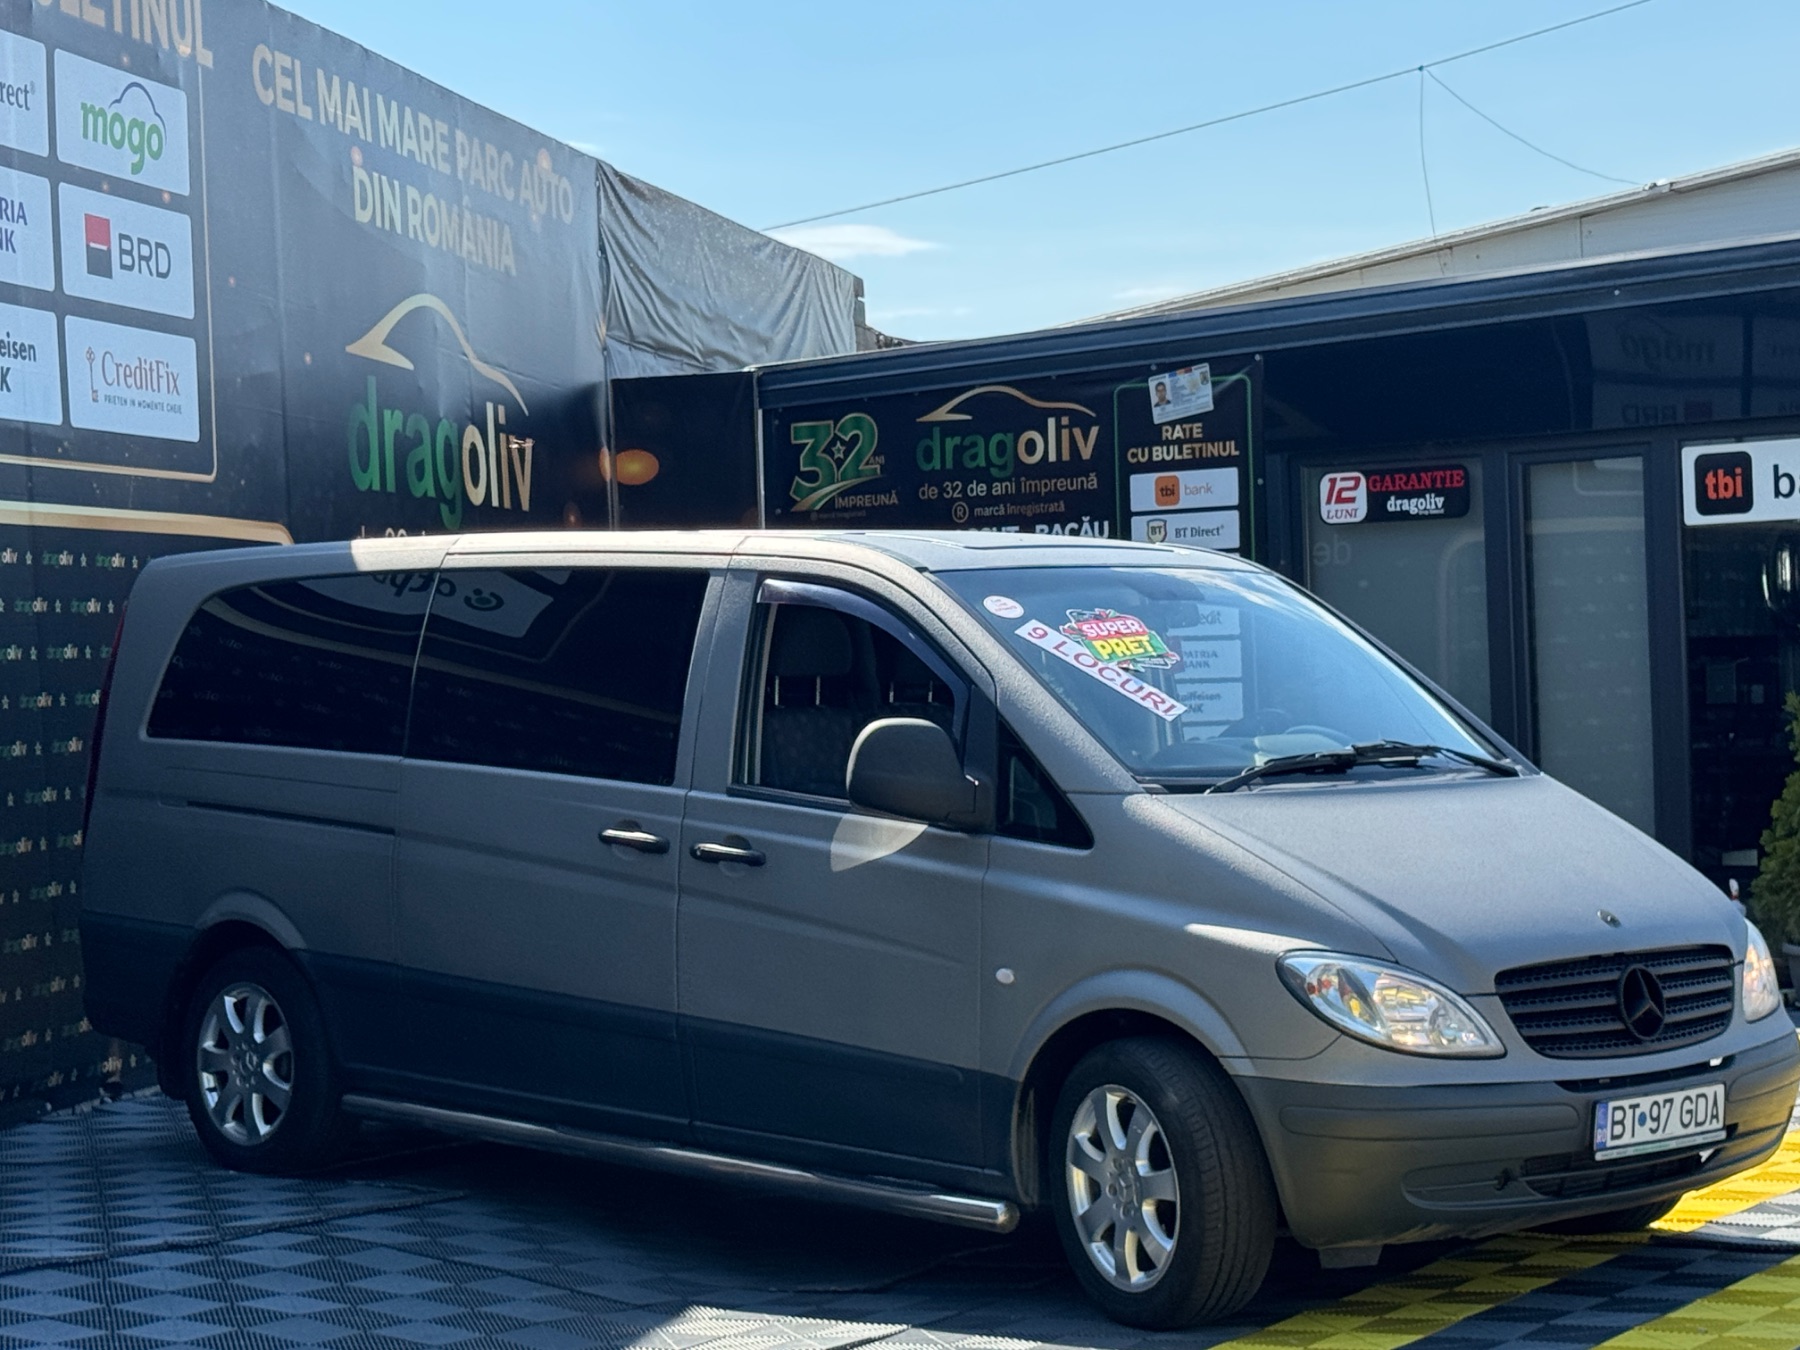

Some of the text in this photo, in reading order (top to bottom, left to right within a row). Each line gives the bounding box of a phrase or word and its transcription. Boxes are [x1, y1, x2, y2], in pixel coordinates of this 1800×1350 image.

[81, 101, 164, 176] mogo
[252, 43, 574, 225] CEL MAI MARE PARC AUTO
[352, 165, 517, 277] DIN ROMÂNIA
[118, 232, 172, 280] BRD
[101, 350, 180, 396] CreditFix
[915, 415, 1100, 478] dragoliv
[1161, 422, 1203, 441] RATE
[350, 375, 535, 531] dragoliv
[789, 412, 881, 501] 32
[1126, 440, 1240, 464] CU BULETINUL
[918, 472, 1098, 500] de 32 de ani împreună
[1159, 482, 1213, 498] tbi bank
[1325, 475, 1361, 506] 12
[1368, 469, 1465, 492] GARANTIE
[1705, 464, 1800, 500] tbi b
[974, 502, 1006, 517] marcă
[1006, 500, 1066, 518] înregistrată
[1326, 508, 1359, 520] LUNI
[1386, 493, 1445, 515] dragoliv
[1174, 528, 1188, 539] BT
[1080, 618, 1144, 638] SUPER
[1027, 626, 1178, 715] 9 LOCURI
[1611, 1090, 1720, 1141] BT 97 GDA
